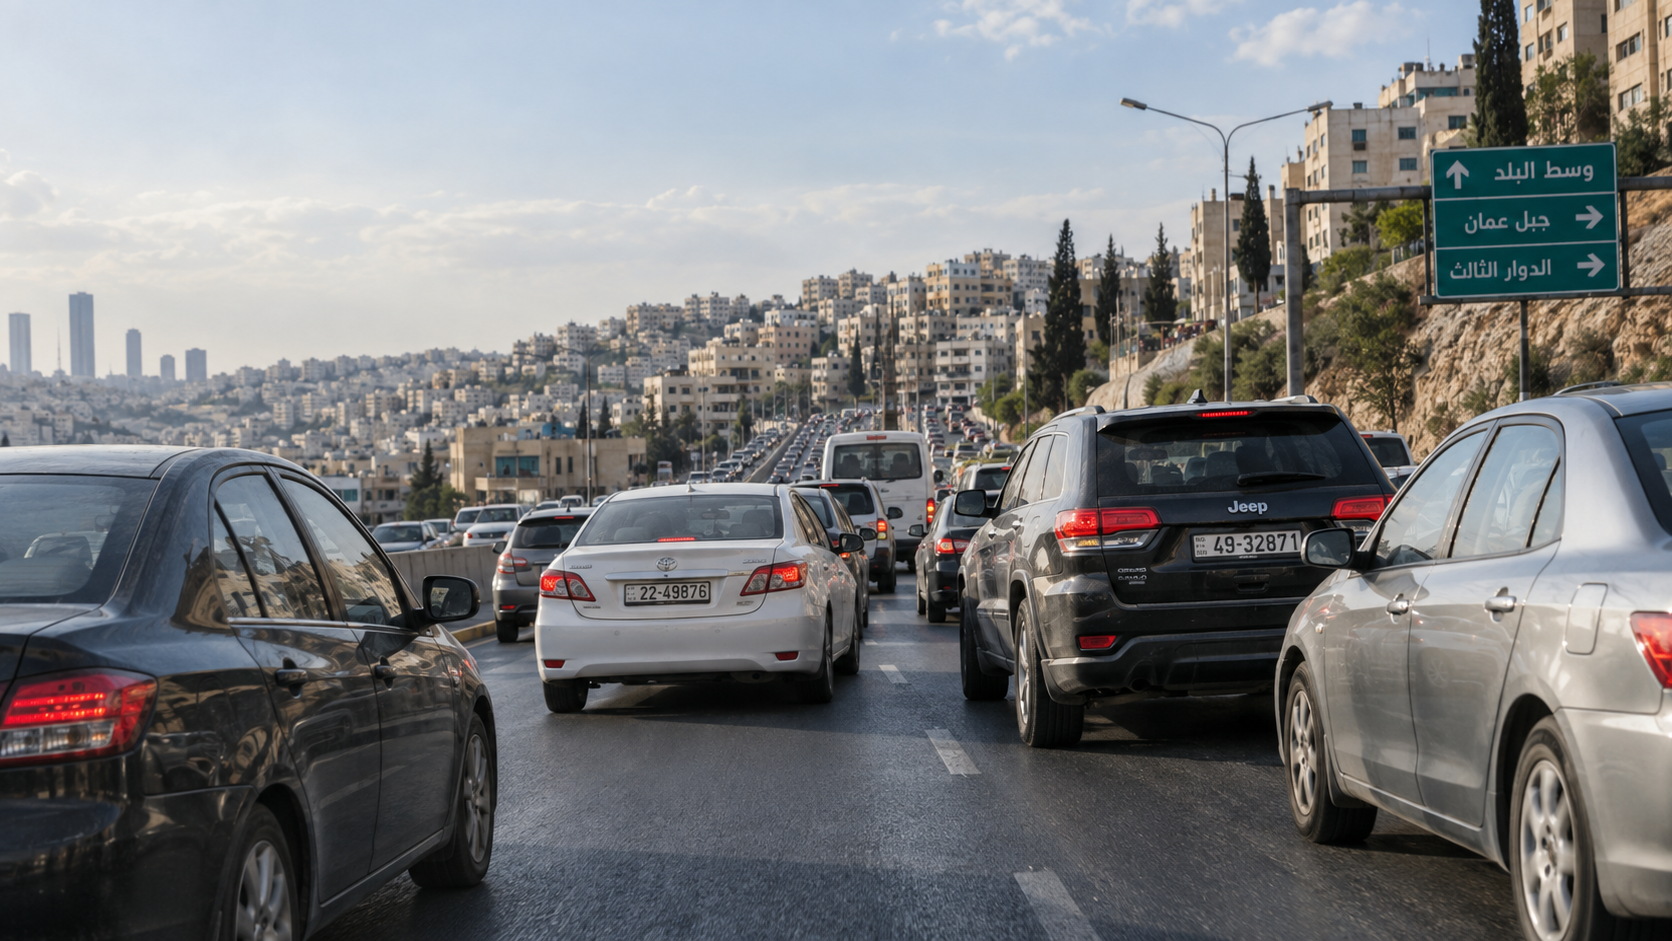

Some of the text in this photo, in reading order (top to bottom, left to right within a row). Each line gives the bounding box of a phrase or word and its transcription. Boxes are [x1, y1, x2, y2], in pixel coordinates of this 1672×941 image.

[1494, 160, 1594, 185] وسط البلد
[1465, 210, 1550, 234] جبل عمان
[1450, 259, 1551, 281] الدوار الثالث
[1227, 500, 1268, 515] Jeep
[1213, 533, 1298, 554] 49-32871
[640, 584, 707, 601] 22-49876
